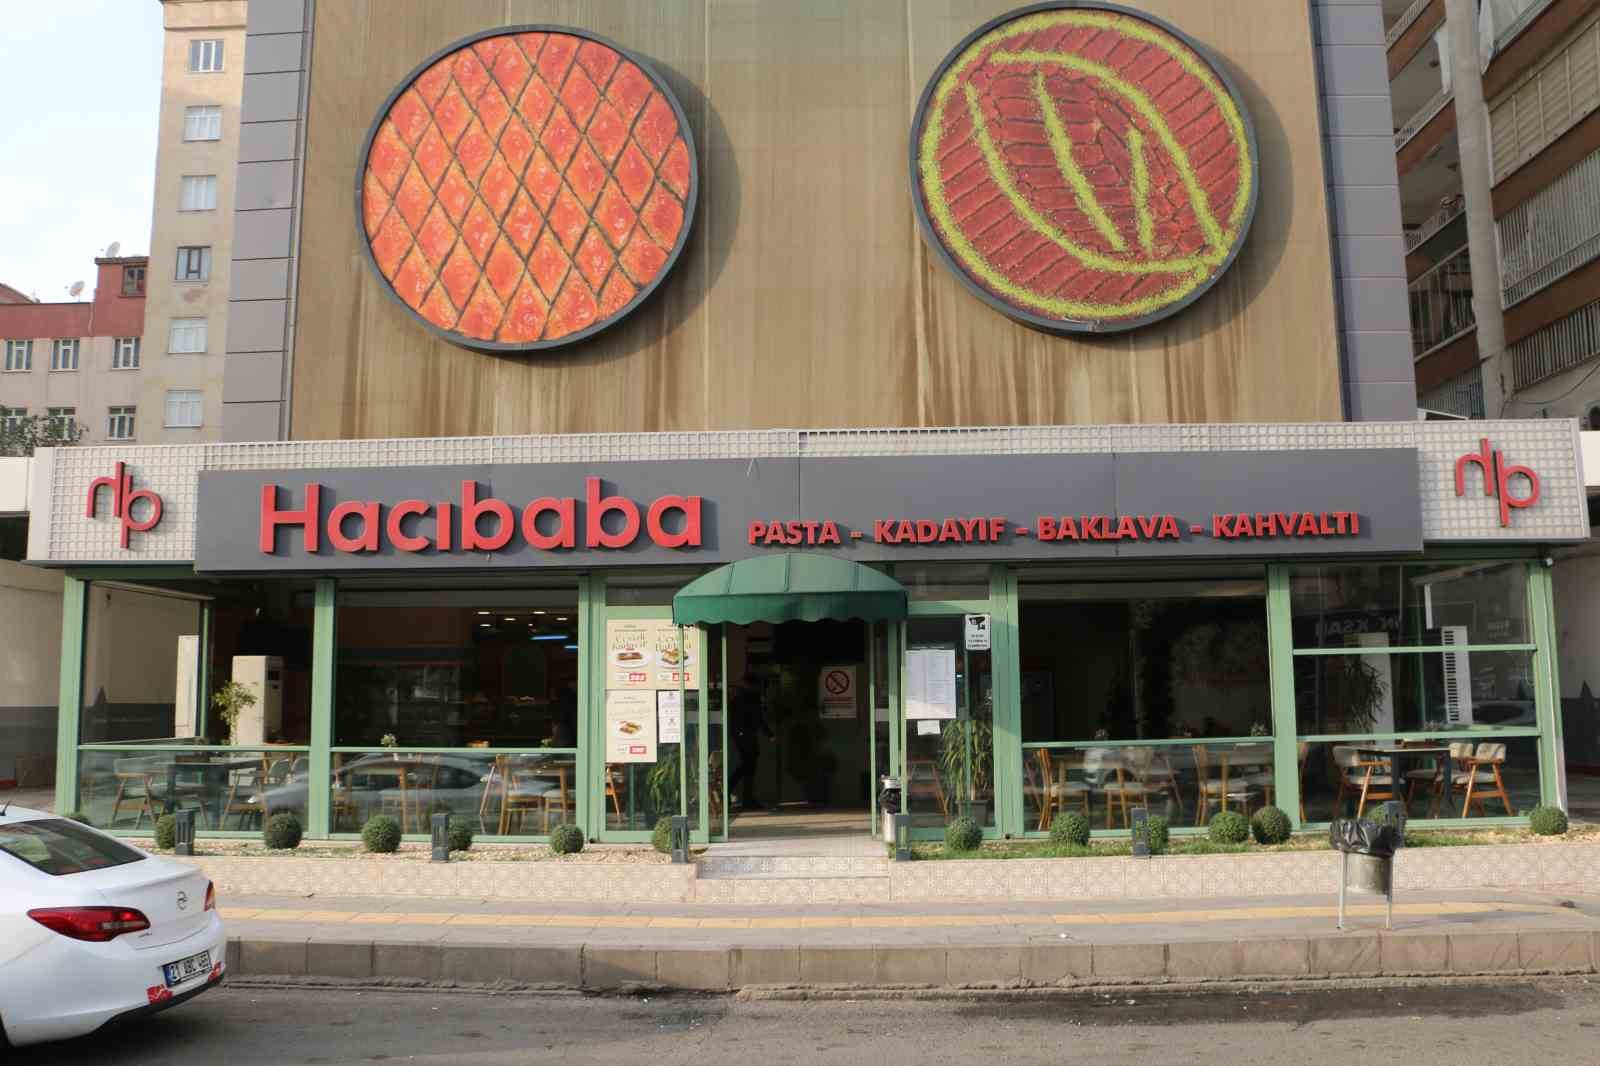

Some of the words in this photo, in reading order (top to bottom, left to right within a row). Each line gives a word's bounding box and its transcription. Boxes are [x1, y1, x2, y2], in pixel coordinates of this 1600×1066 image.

[259, 477, 703, 554] Hacıbaba
[748, 520, 841, 545] PASTA
[874, 517, 1006, 543] KADAYIF
[1037, 514, 1181, 542] BAKLAVA
[1212, 511, 1360, 539] KAHVALTI
